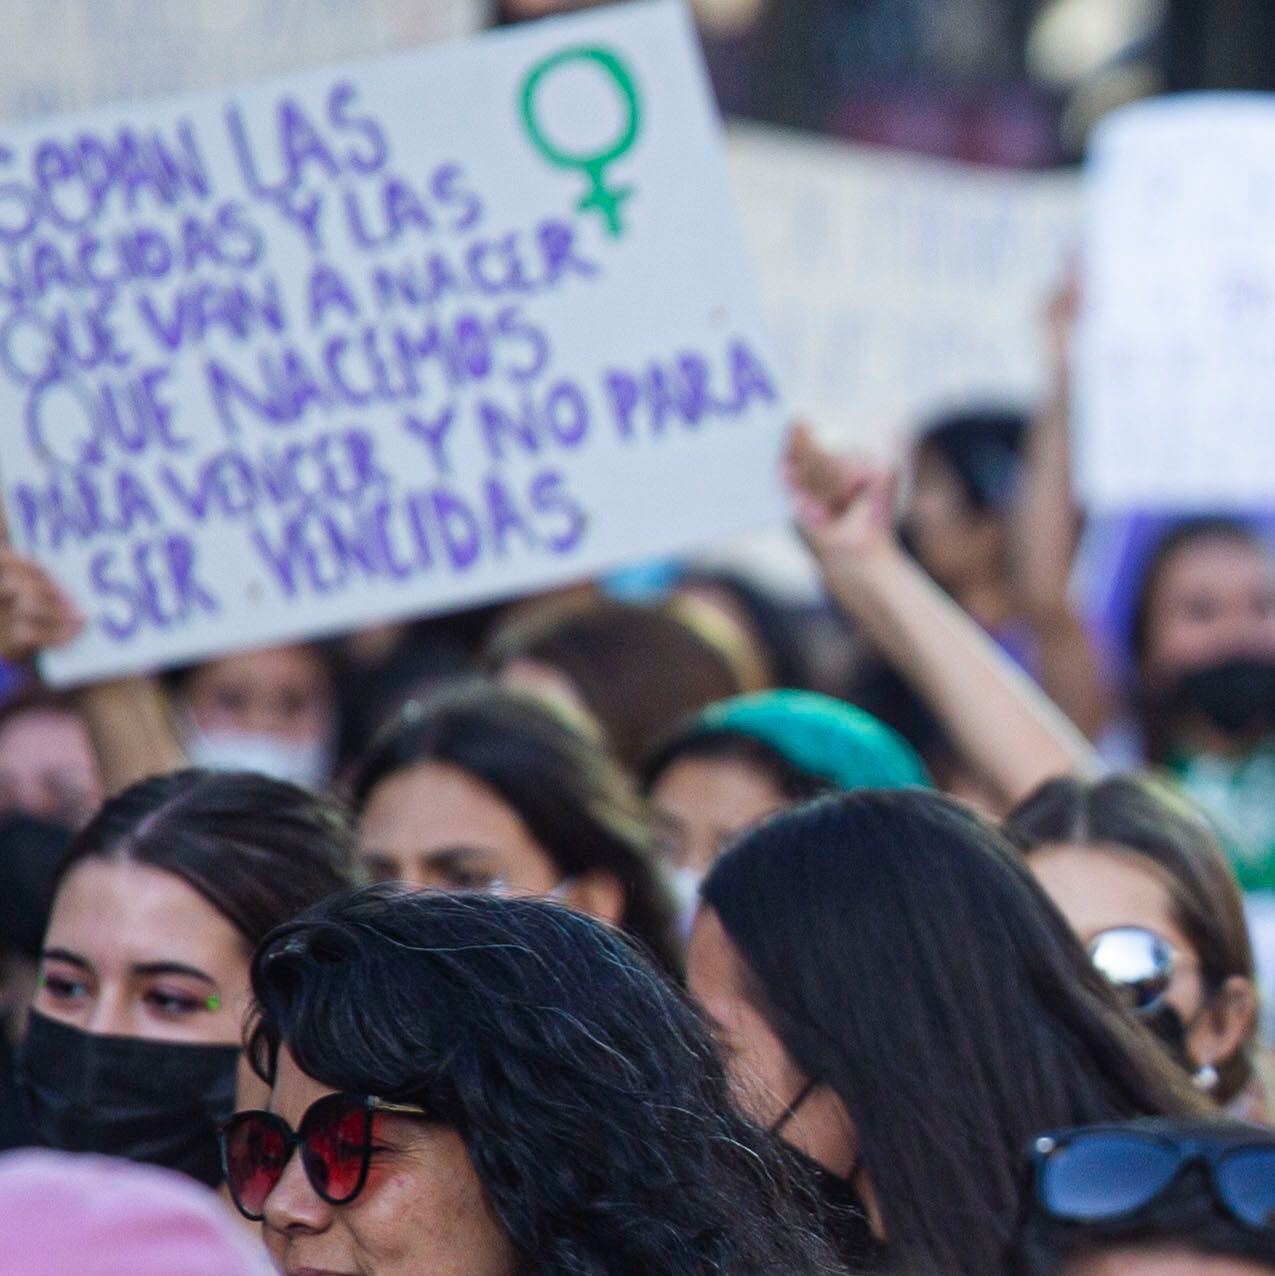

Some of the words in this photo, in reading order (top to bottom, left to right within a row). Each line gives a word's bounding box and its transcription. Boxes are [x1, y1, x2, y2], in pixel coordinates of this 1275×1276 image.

[223, 78, 390, 199] LAS
[343, 163, 484, 250] LAS
[137, 271, 285, 352] VAN
[308, 262, 361, 330] A
[371, 218, 602, 307] NACER
[24, 363, 196, 468] QUE
[205, 306, 550, 440] NACIMOS
[404, 402, 457, 474] Y
[477, 378, 590, 458] NO
[604, 336, 780, 443] PARA
[89, 536, 220, 642] SER
[252, 469, 588, 598] VENCIDAS
